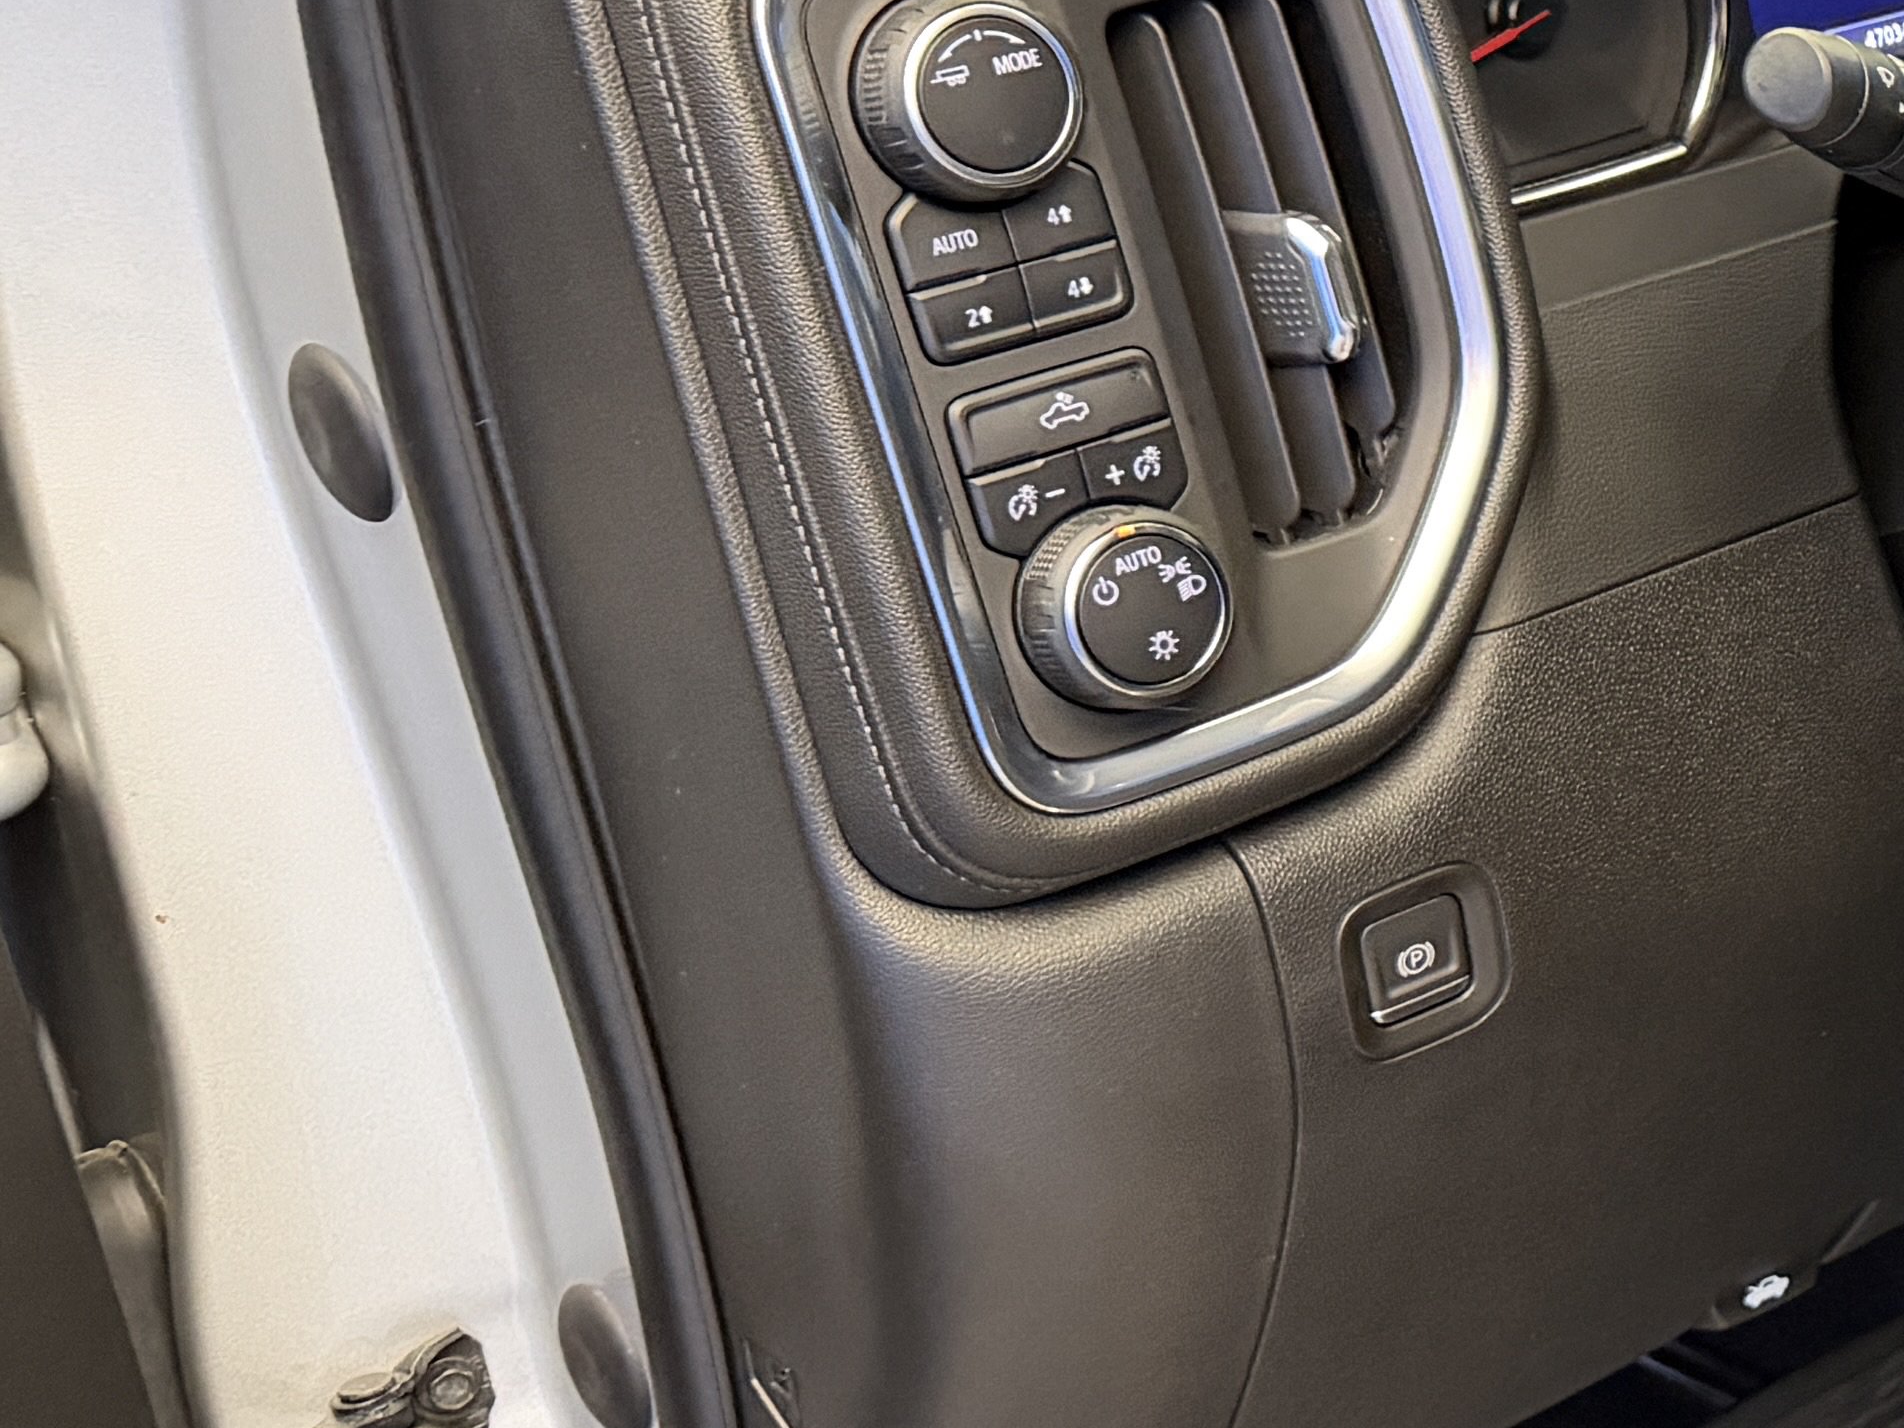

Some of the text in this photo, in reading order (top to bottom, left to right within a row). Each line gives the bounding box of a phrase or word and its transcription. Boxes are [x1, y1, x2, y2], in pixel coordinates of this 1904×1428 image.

[991, 48, 1043, 76] MODE
[932, 228, 979, 256] AUTO
[1114, 545, 1162, 576] AUTO
